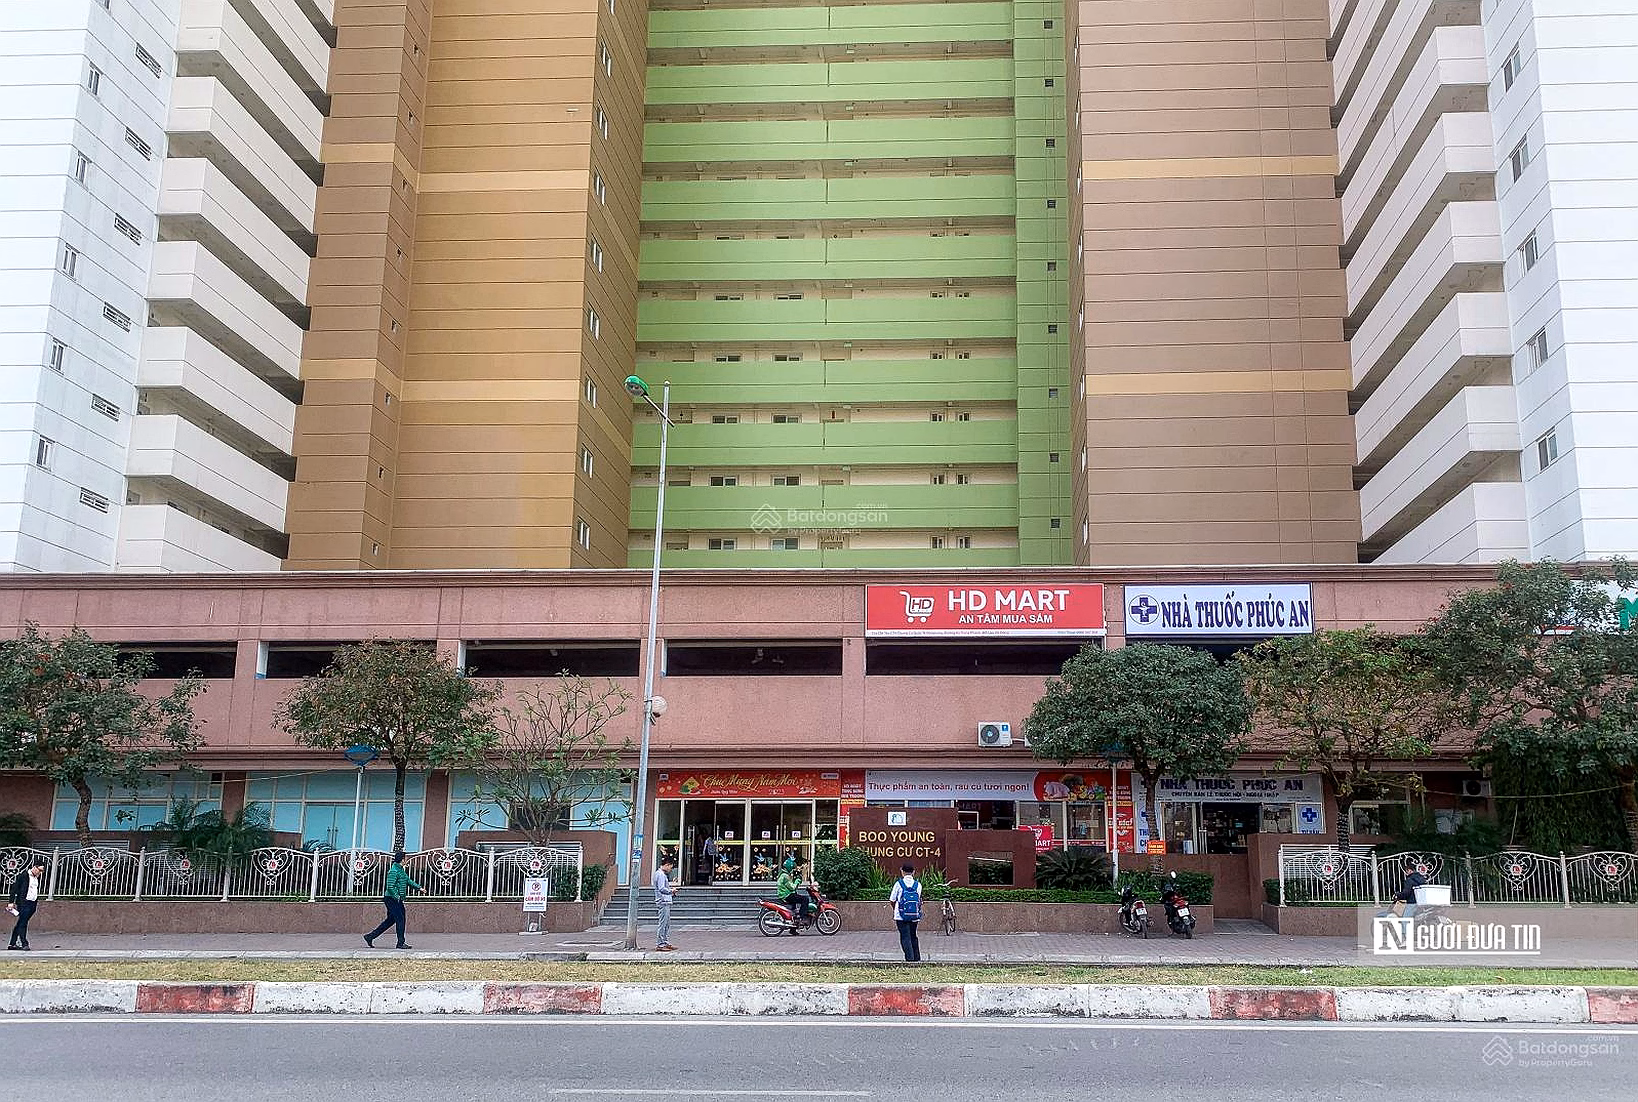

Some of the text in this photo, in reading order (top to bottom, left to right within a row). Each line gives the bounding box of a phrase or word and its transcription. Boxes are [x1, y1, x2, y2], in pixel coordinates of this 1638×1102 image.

[911, 598, 932, 610] HD
[948, 589, 1070, 611] HD MART
[1160, 590, 1310, 628] NHÀ THUỐC PHÚC AN
[958, 614, 975, 624] AN
[977, 612, 1000, 624] TÂM
[1002, 614, 1027, 624] MUA
[868, 782, 891, 792] Thực
[917, 783, 929, 791] an
[955, 783, 969, 791] rau
[1004, 783, 1030, 793] ngon!
[1284, 779, 1304, 791] AN
[858, 830, 936, 844] BOO YOUNG
